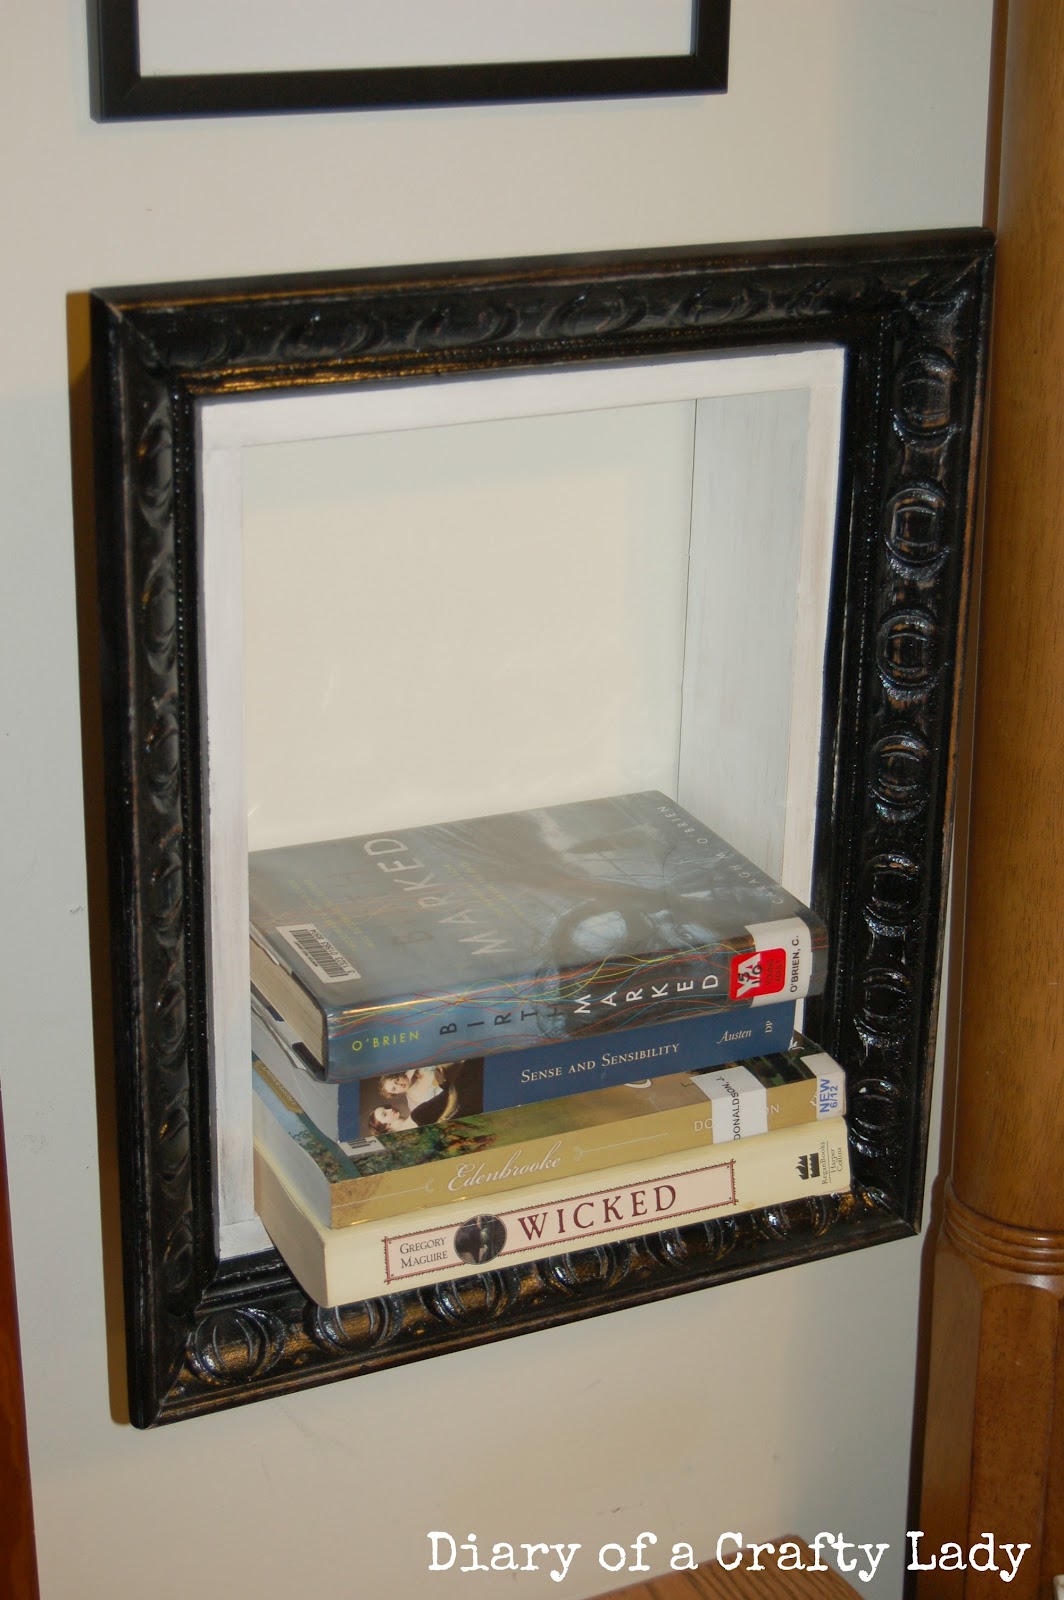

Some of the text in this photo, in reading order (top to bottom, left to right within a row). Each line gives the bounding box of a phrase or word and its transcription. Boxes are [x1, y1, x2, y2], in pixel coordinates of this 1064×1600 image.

[656, 805, 709, 844] O'BRIEN
[363, 837, 515, 956] MARKED
[736, 952, 761, 998] YA
[789, 935, 801, 993] O'BRIEN, C.
[573, 974, 720, 1015] MARKED
[351, 1030, 420, 1052] O'BRIEN
[439, 1006, 566, 1036] BIRTH
[520, 1065, 563, 1084] SENSE
[568, 1060, 597, 1076] AND
[601, 1043, 681, 1068] SENSIBILITY
[716, 1029, 752, 1045] Austen
[721, 1080, 741, 1141] DONALDSON,
[819, 1078, 831, 1113] NEW
[829, 1084, 839, 1109] 6/12
[447, 1140, 562, 1192] Edenbrooke
[821, 1141, 829, 1185] ReganBooks
[518, 1185, 677, 1241] WICKED
[400, 1237, 447, 1255] GREGORY
[400, 1251, 449, 1269] MAGUIRE
